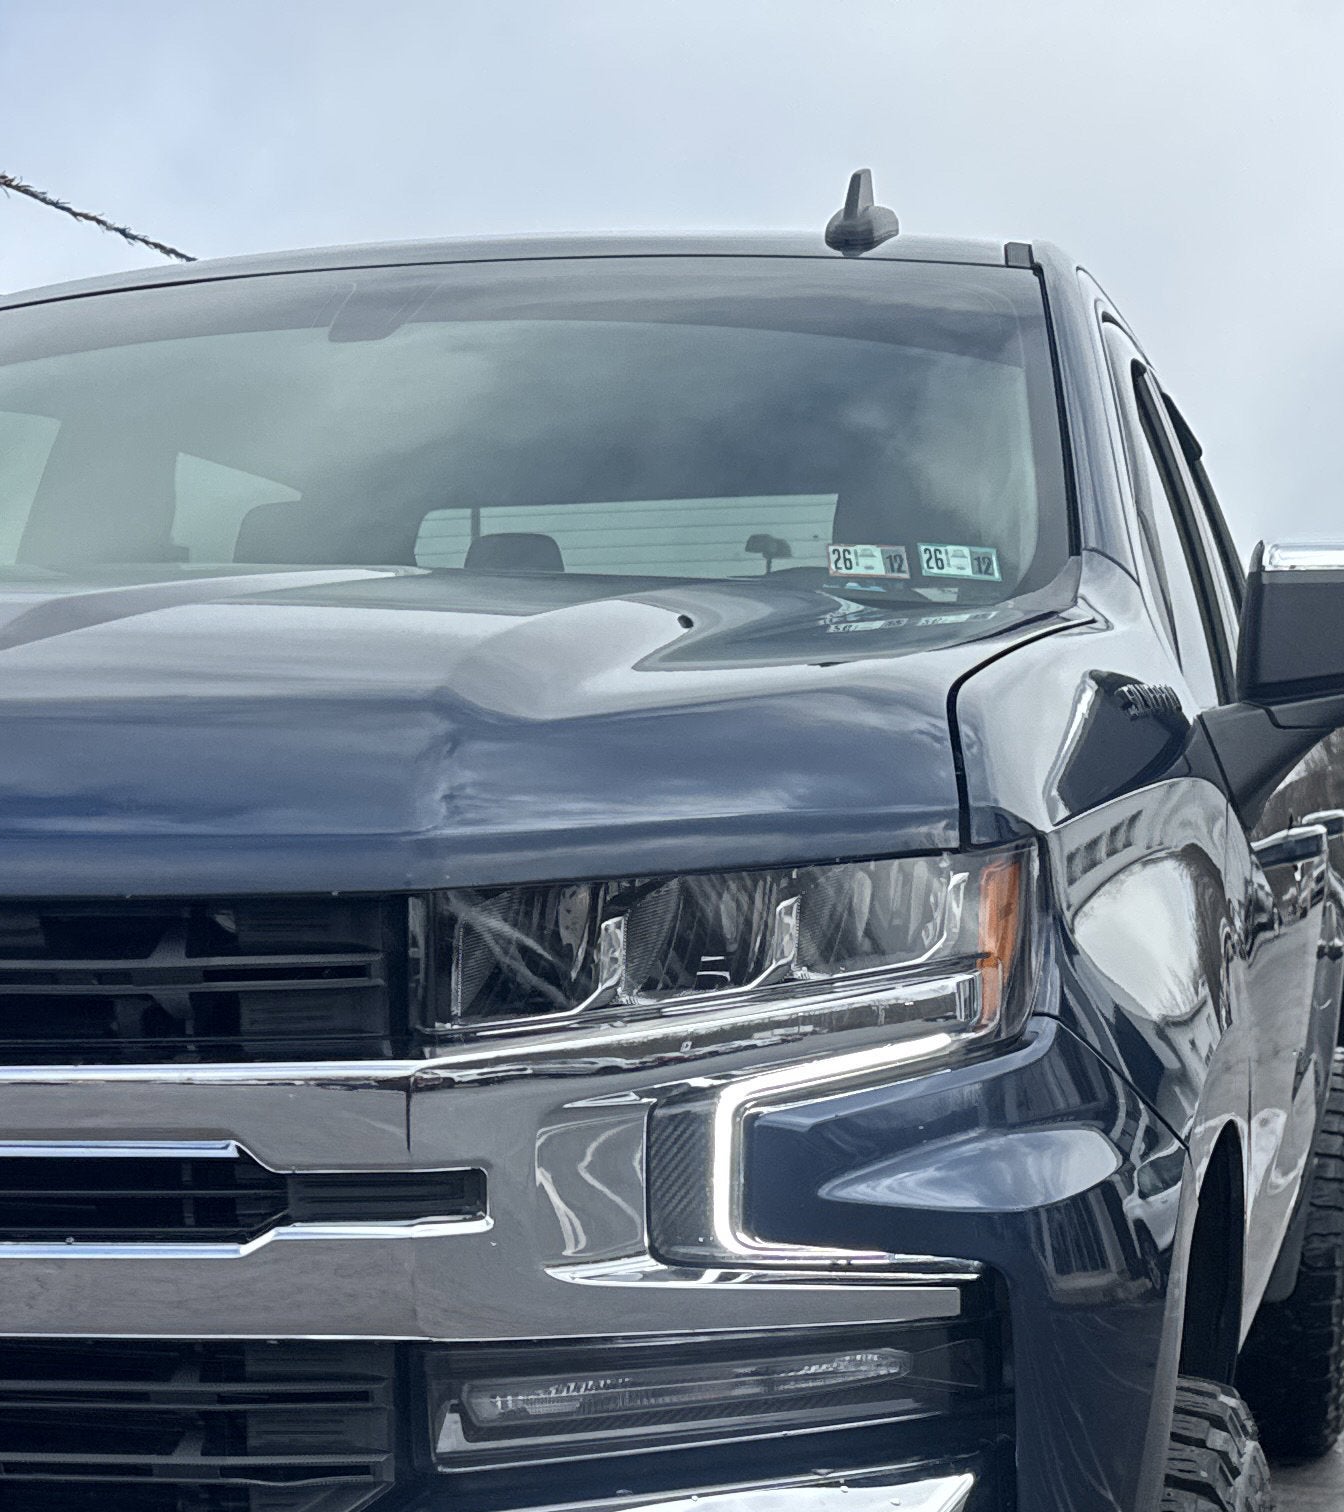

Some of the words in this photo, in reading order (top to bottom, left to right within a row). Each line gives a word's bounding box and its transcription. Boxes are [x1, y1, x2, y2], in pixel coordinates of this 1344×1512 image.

[832, 548, 853, 570] 26
[886, 554, 907, 573] 12
[923, 547, 944, 570] 26
[974, 556, 994, 575] 12
